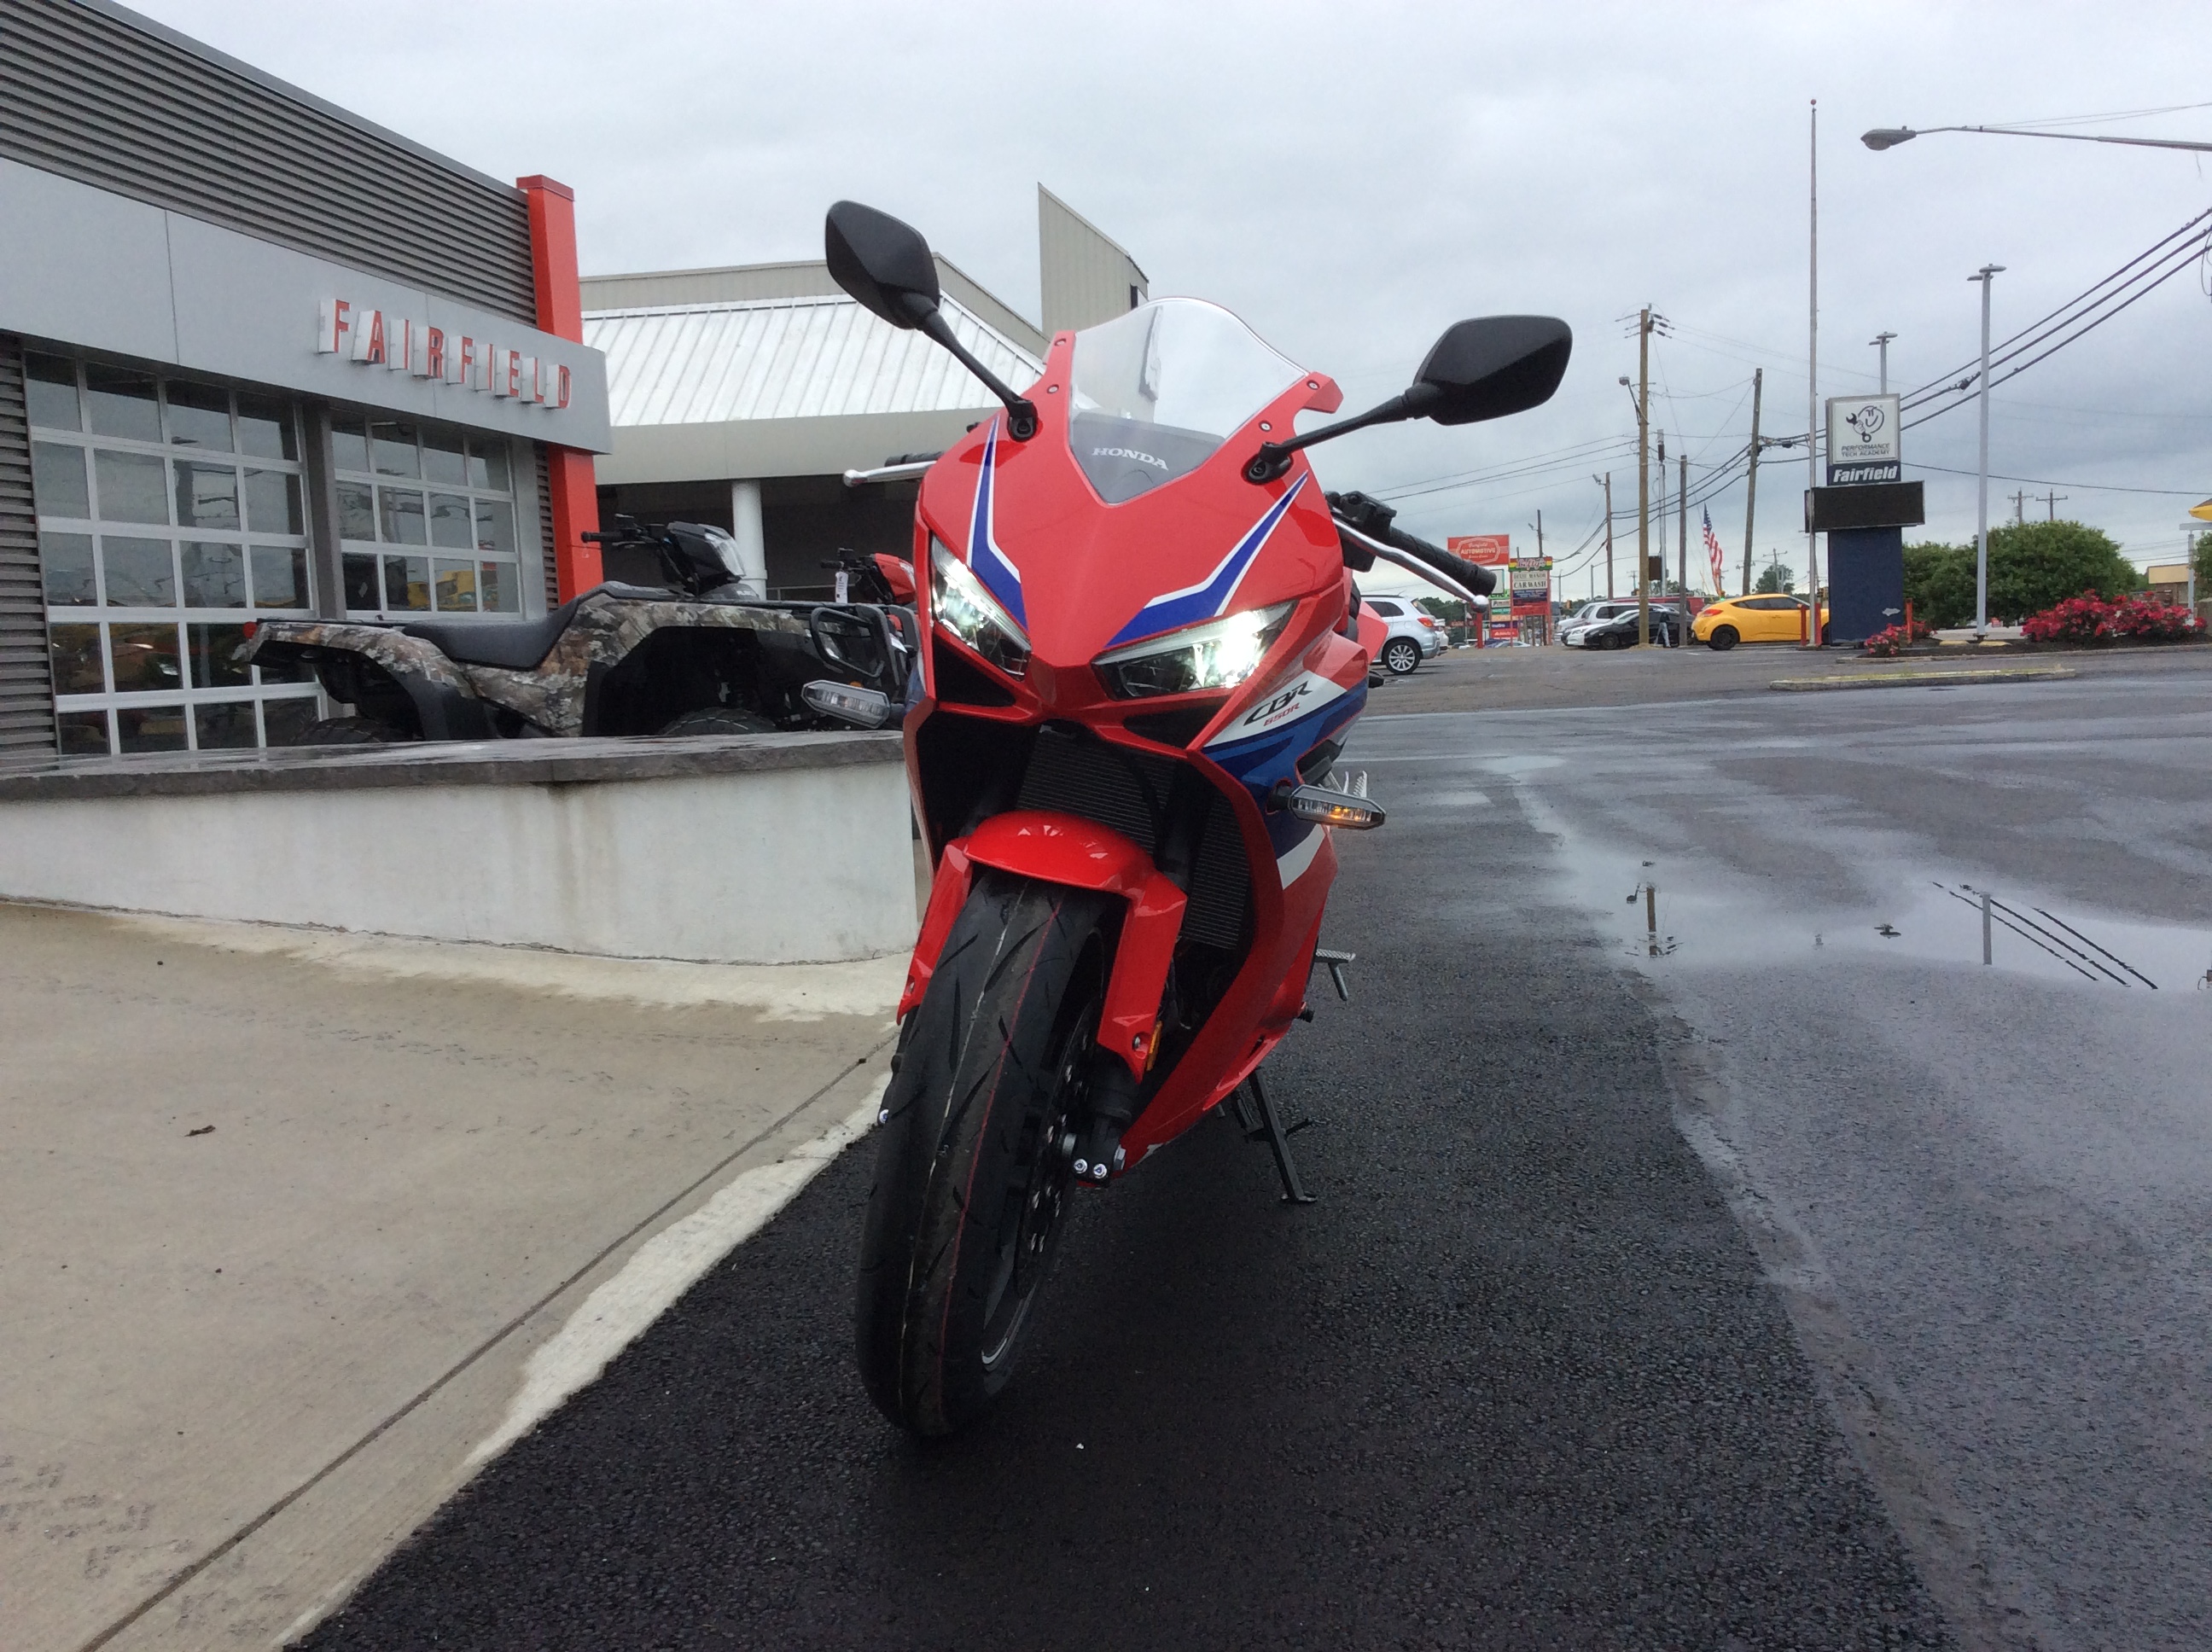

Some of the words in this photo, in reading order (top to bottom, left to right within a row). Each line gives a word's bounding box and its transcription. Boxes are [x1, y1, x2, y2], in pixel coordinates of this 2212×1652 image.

[318, 299, 572, 410] FAIRFIELD
[1091, 447, 1169, 470] HONDA
[1841, 443, 1890, 451] PERFORMANCE
[1833, 466, 1898, 483] Fairfield
[1243, 680, 1313, 726] CBR
[1263, 702, 1301, 727] 650R
